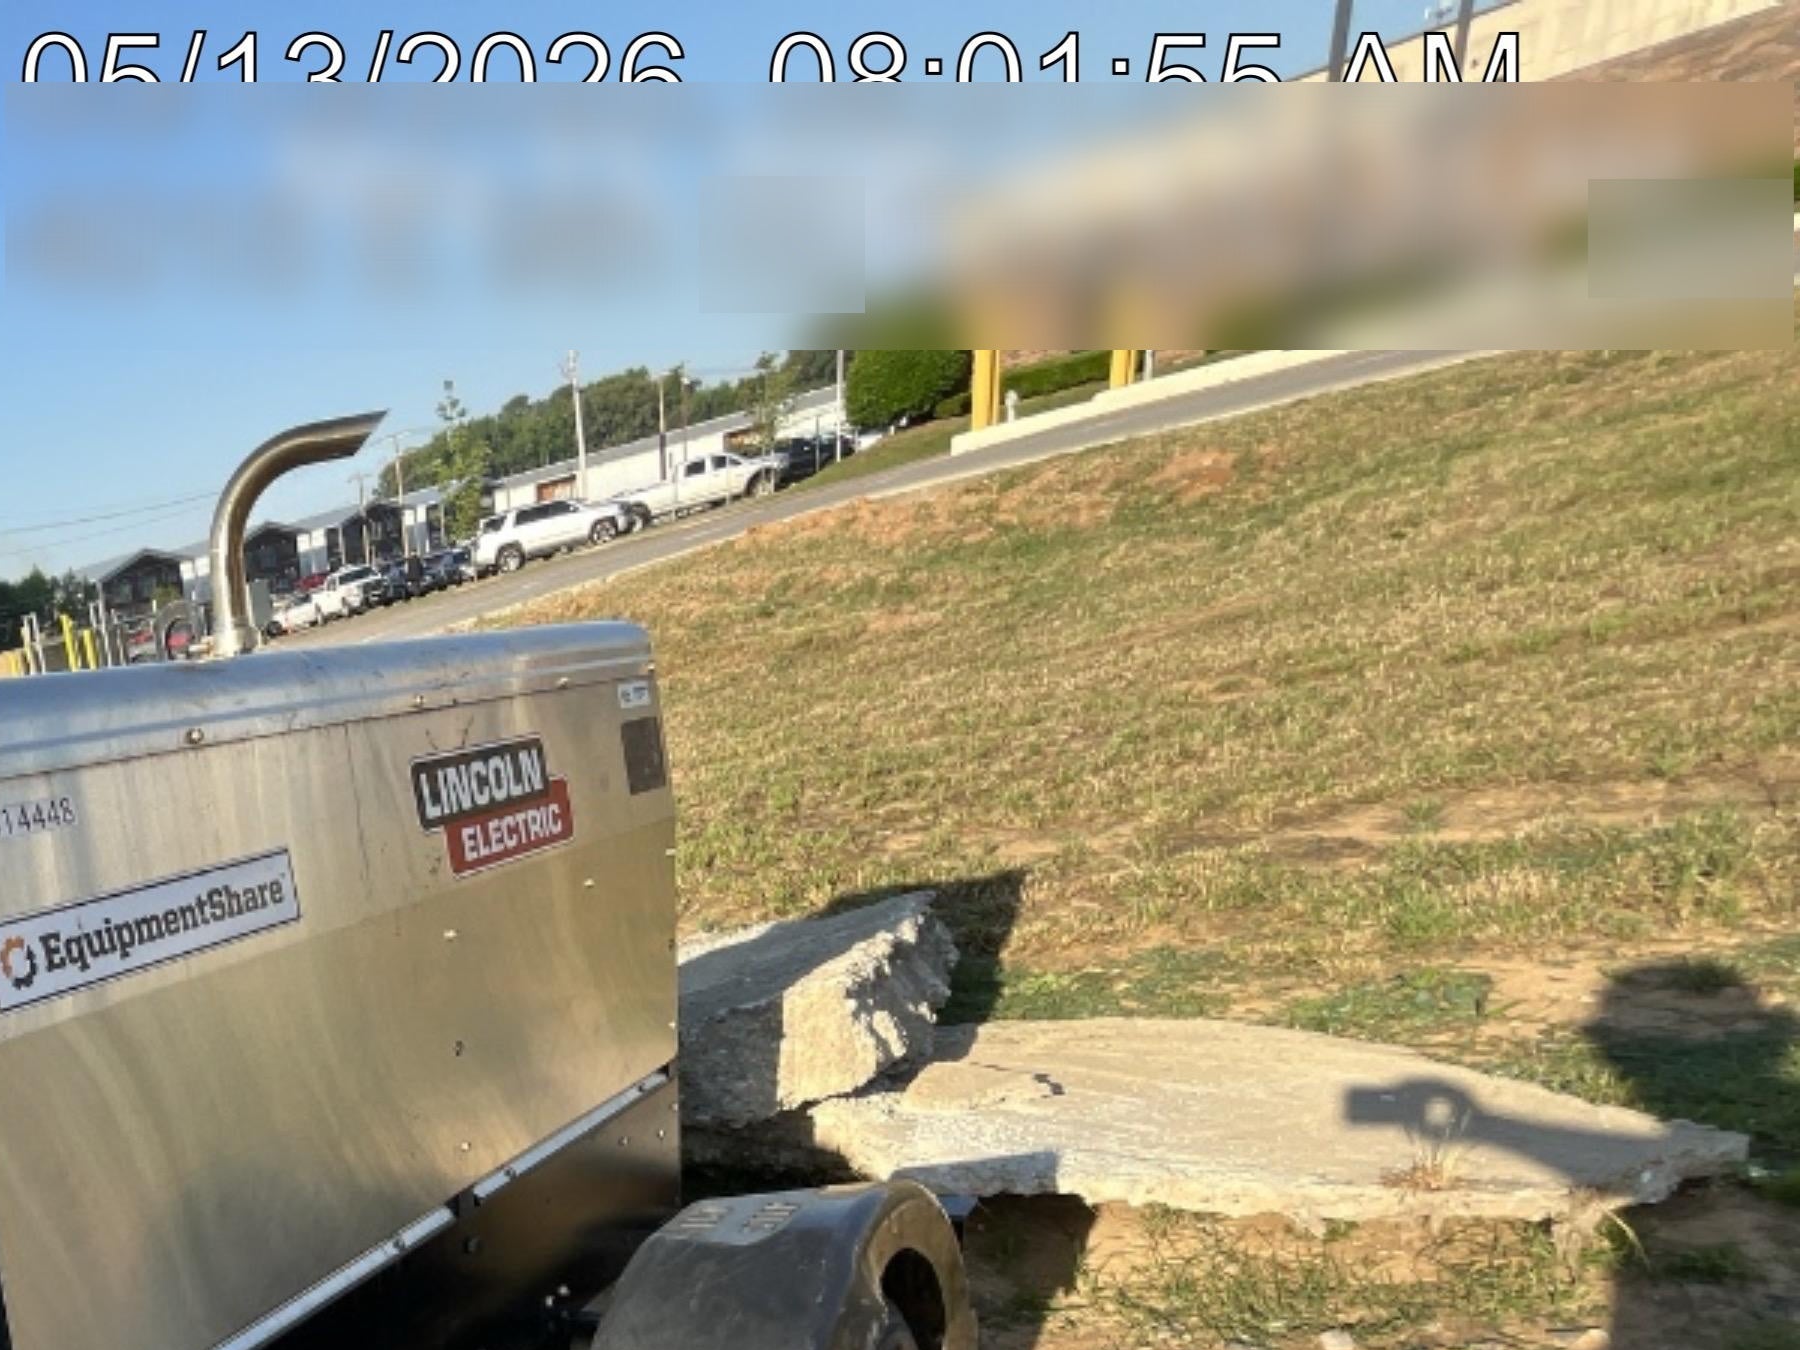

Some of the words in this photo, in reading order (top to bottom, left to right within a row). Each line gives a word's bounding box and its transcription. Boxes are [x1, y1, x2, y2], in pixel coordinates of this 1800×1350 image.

[419, 747, 545, 819] LINCOLN
[461, 803, 562, 862] ELECTRIC
[38, 876, 286, 974] EquipmentShare
